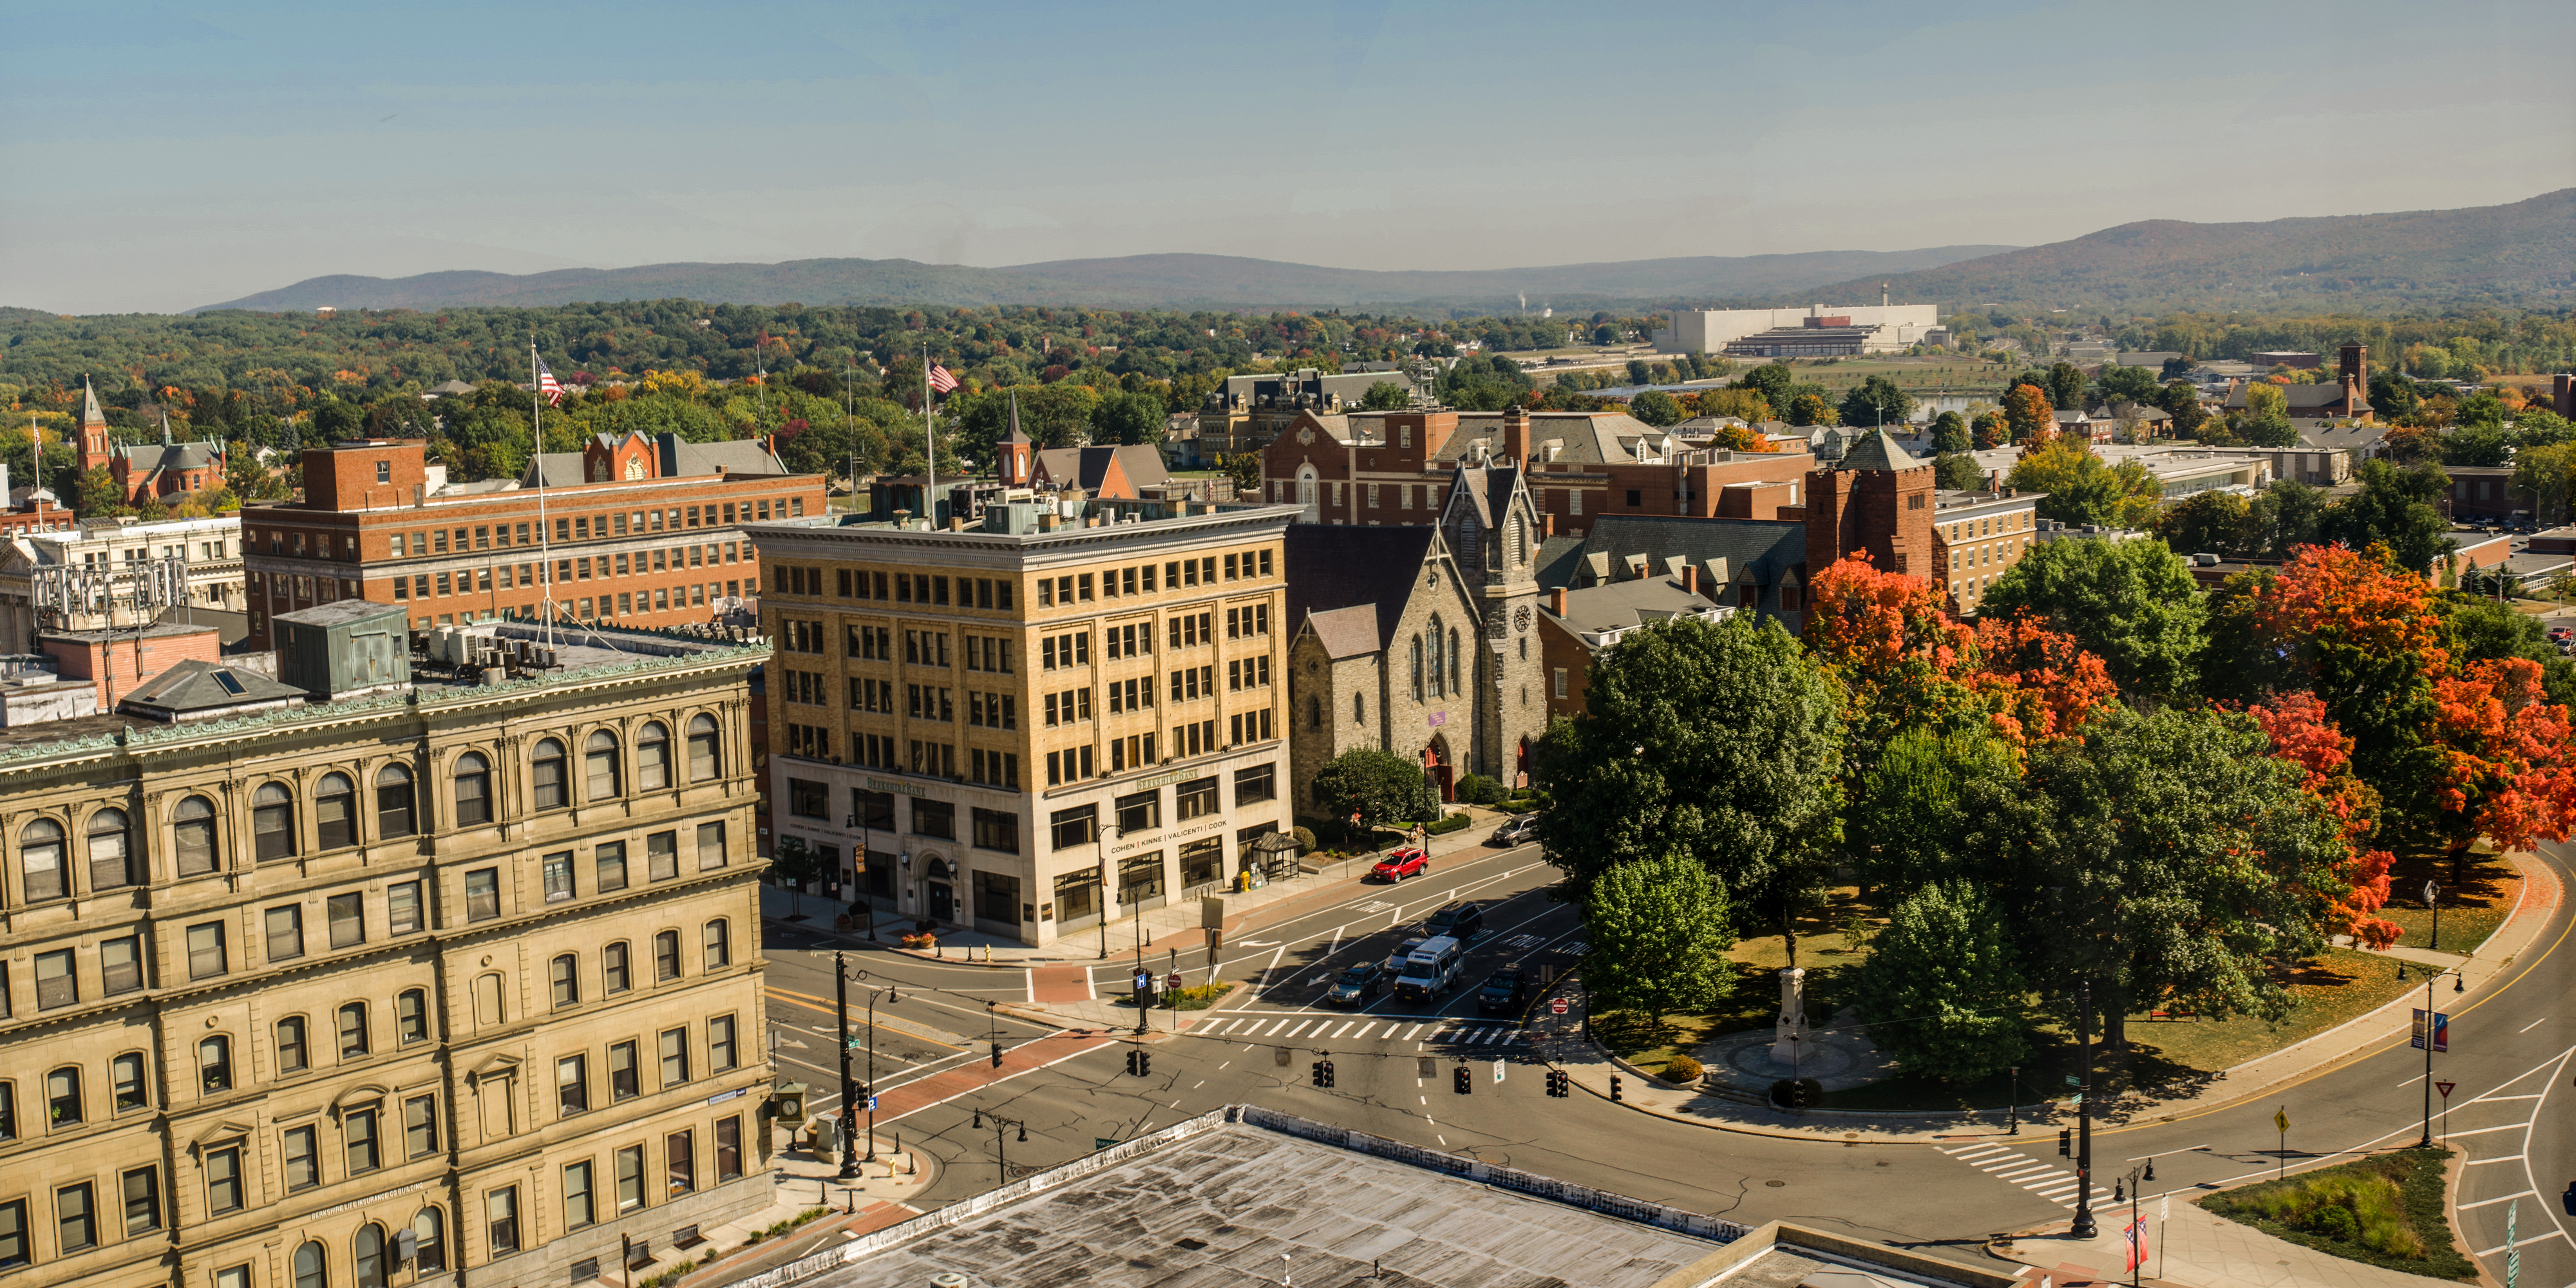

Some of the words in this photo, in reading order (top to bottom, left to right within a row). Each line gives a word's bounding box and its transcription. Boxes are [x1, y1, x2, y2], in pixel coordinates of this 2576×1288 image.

[1111, 842, 1135, 854] COHEN
[1141, 836, 1162, 846] KINNE
[1168, 826, 1203, 839] VALICENTI
[1209, 820, 1227, 830] COOK
[1499, 934, 1546, 948] ONLY
[1139, 976, 1145, 987] H
[868, 1099, 874, 1112] P
[311, 1206, 344, 1220] BERKSHIRE
[344, 1200, 357, 1211] LIFE
[357, 1191, 389, 1207] INSURANCE
[397, 1182, 423, 1195] BUILDING
